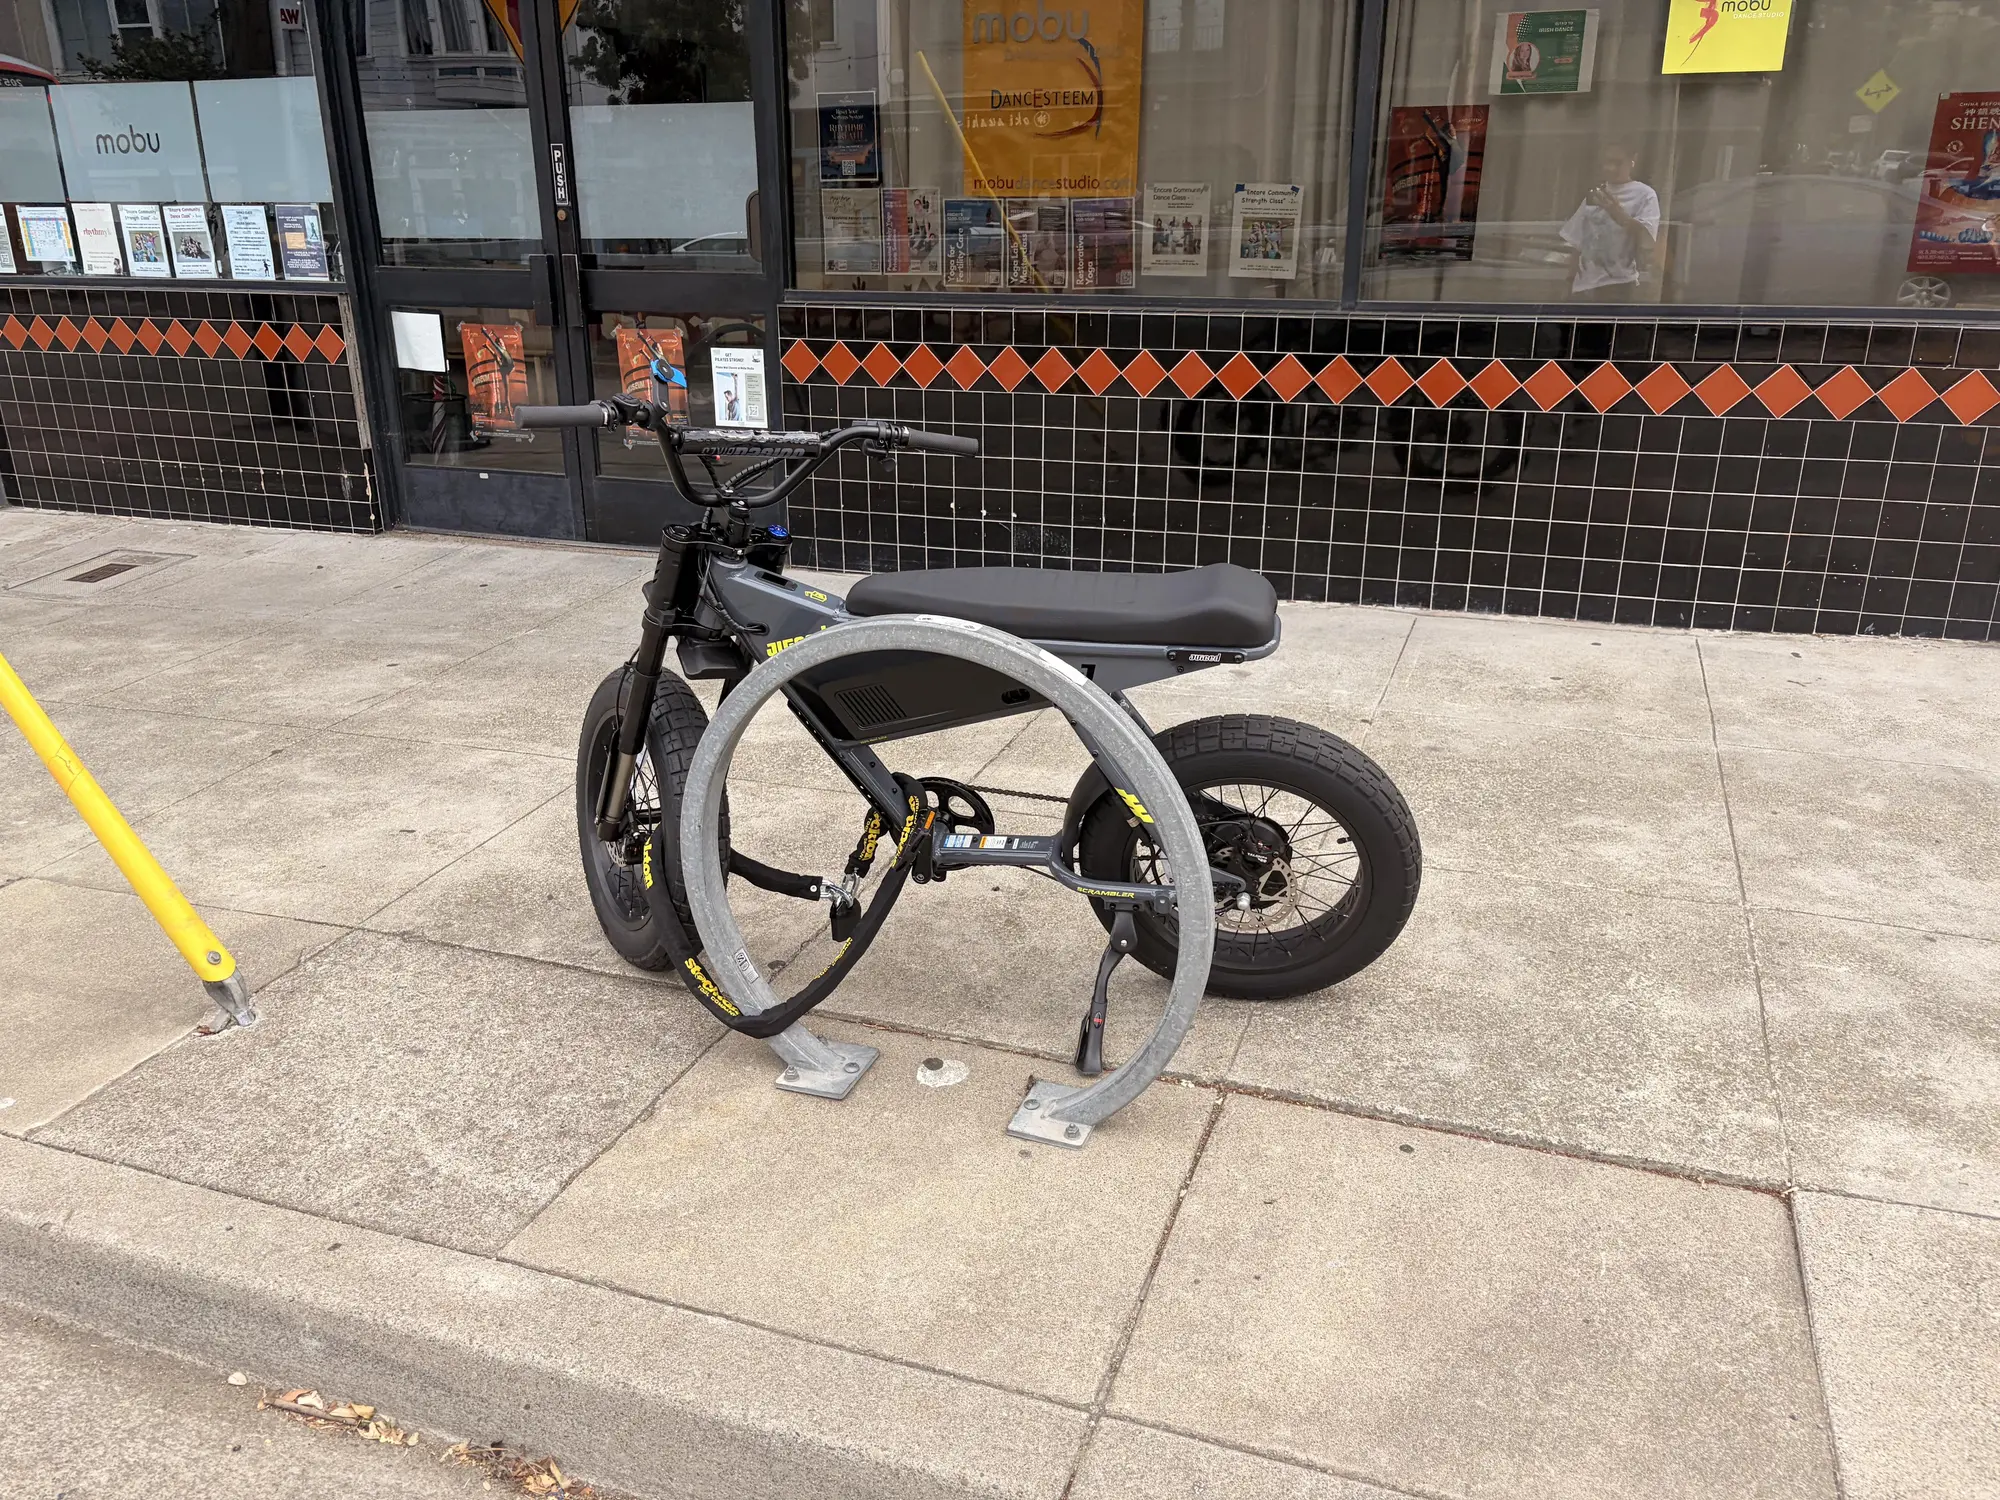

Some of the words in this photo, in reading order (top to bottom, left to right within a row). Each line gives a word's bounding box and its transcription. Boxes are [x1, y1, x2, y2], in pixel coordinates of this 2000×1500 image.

[1721, 0, 1771, 12] mobu
[973, 0, 1090, 43] mobu
[1951, 117, 2000, 130] SHEN
[96, 124, 160, 154] mobu
[554, 150, 565, 199] PUSH
[1241, 197, 1267, 205] Strength
[956, 227, 964, 250] Care
[1010, 242, 1019, 259] Lab
[1076, 235, 1084, 285] Restorative
[947, 262, 957, 283] Yoga
[1010, 261, 1020, 284] Yoga
[1085, 261, 1095, 285] Yoga
[1076, 886, 1135, 899] SCRAMBLER
